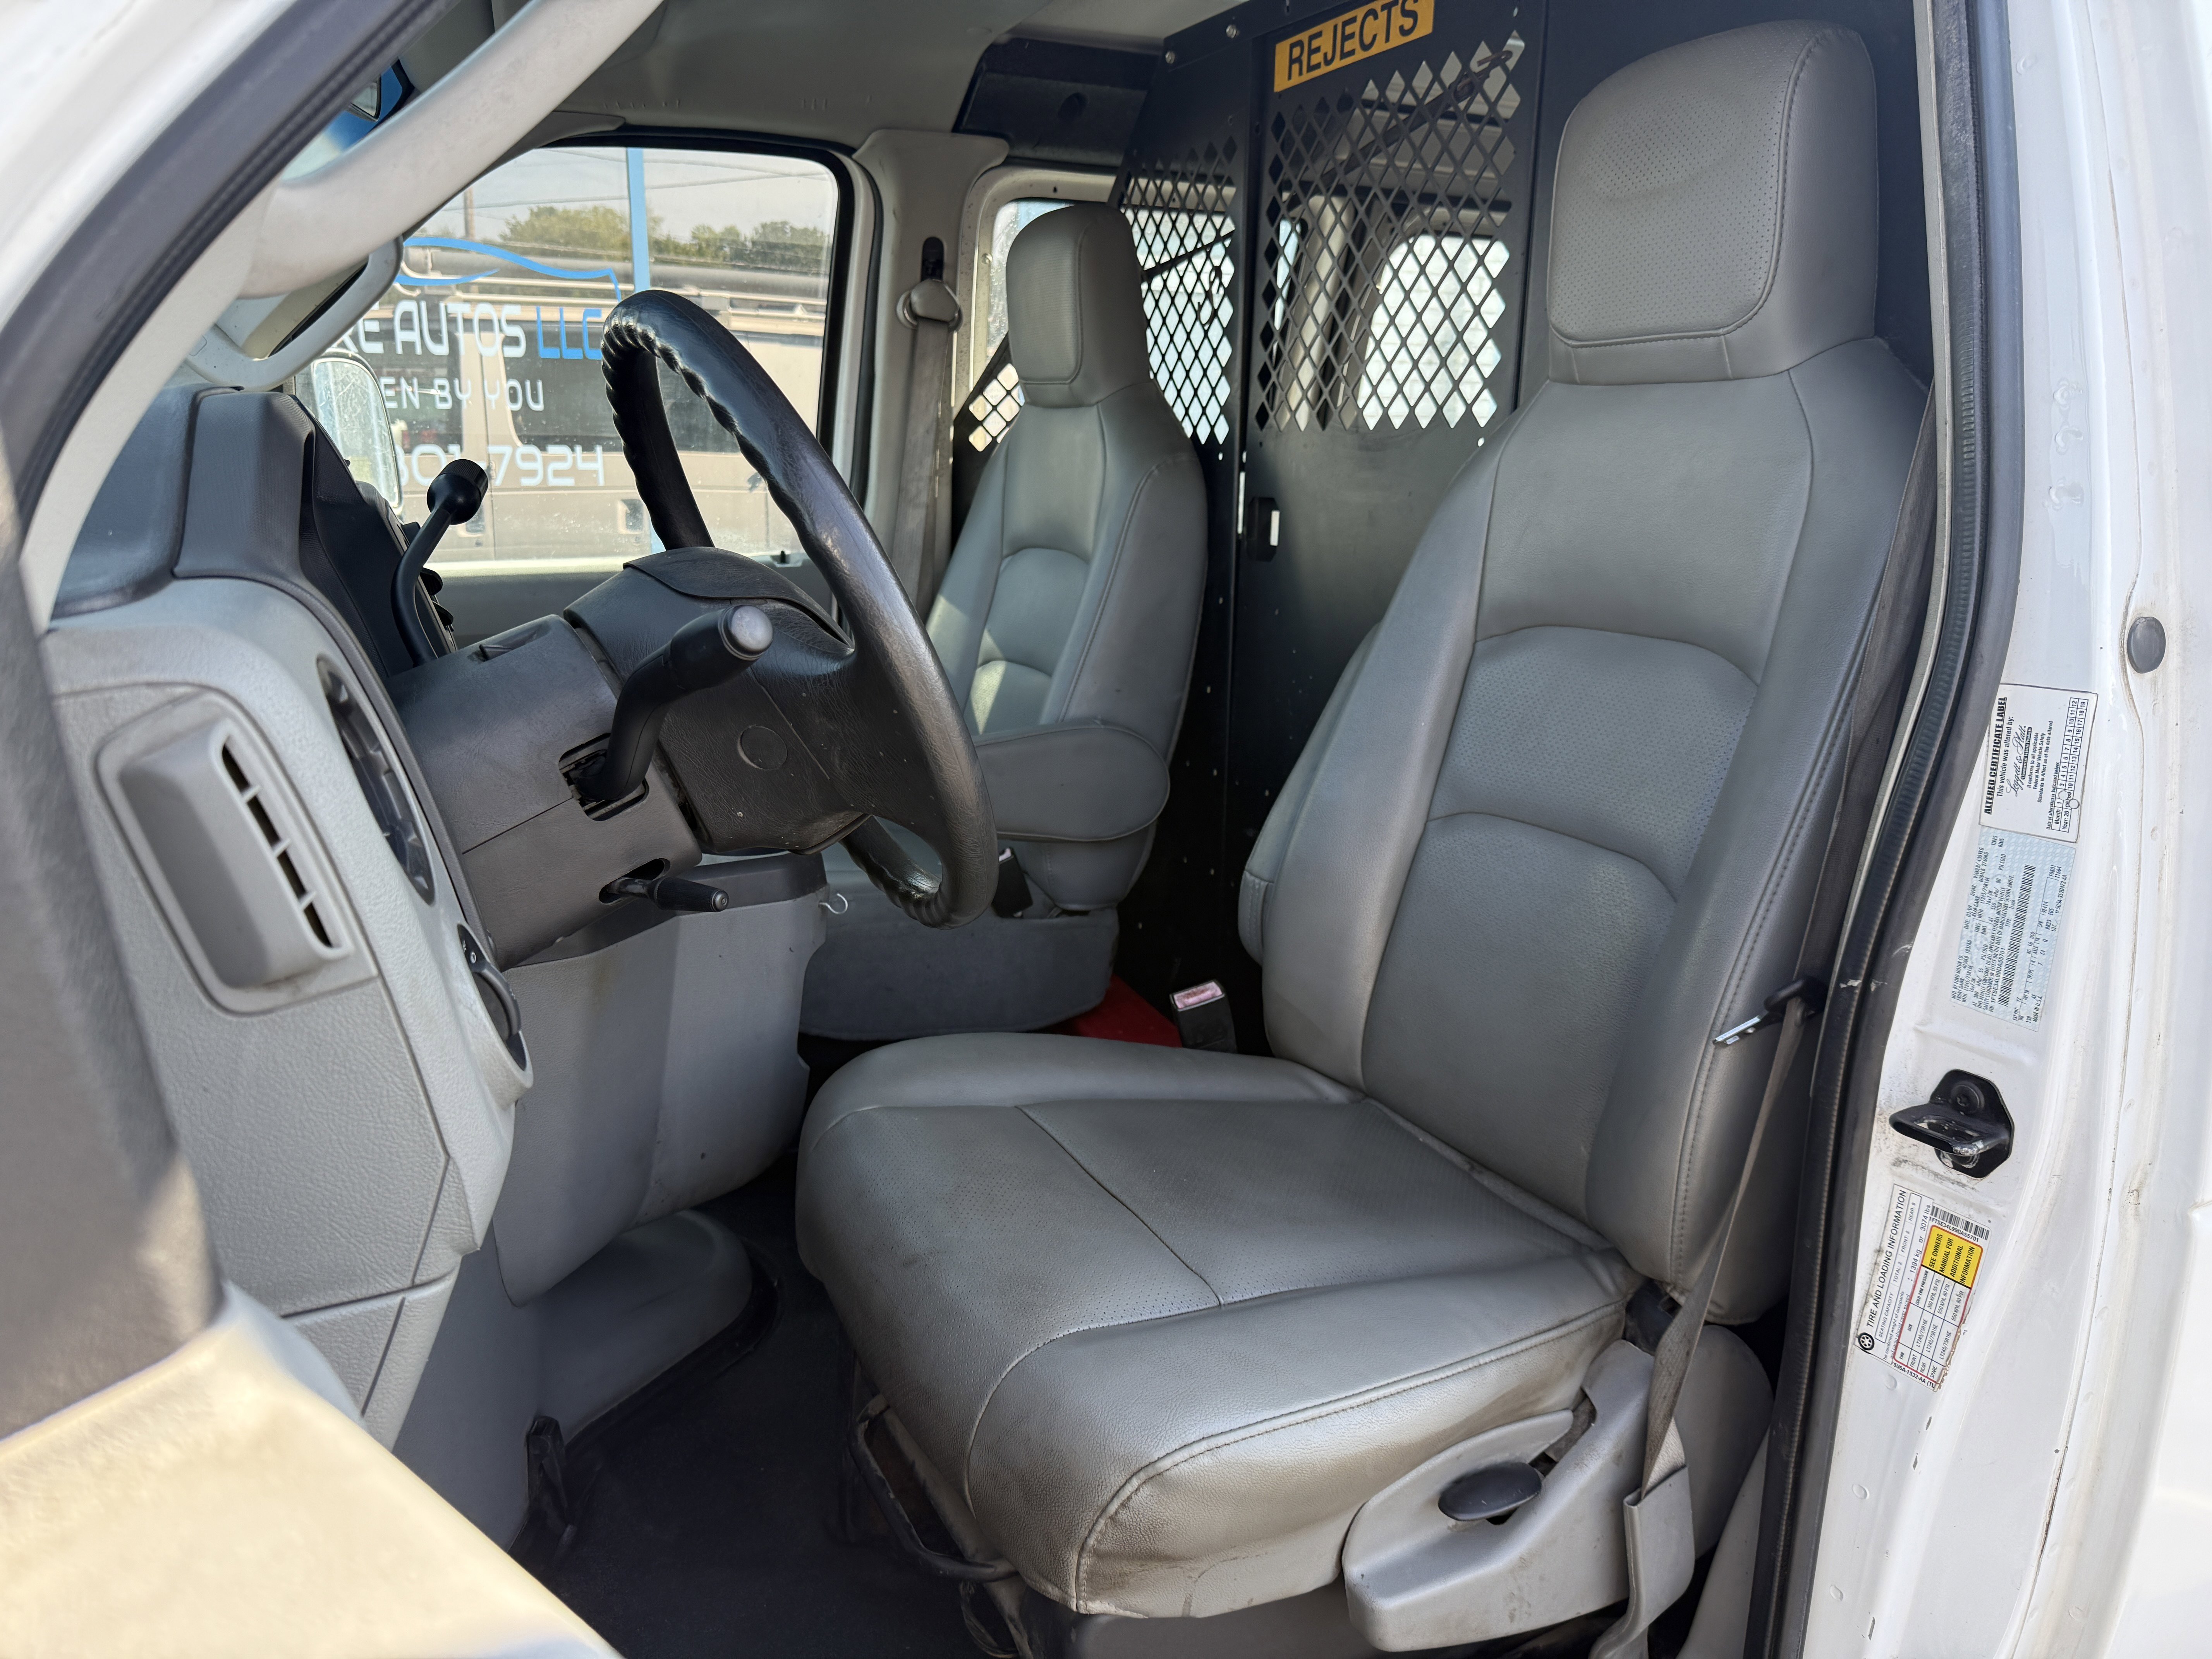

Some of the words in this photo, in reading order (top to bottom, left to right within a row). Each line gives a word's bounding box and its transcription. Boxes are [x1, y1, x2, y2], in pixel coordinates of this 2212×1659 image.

[1288, 0, 1418, 81] REJECTS
[393, 300, 526, 358] AUTOS
[536, 306, 603, 360] LLC
[434, 378, 471, 409] BY
[484, 379, 544, 411] YOU
[1996, 697, 2006, 722] LABEL
[2006, 716, 2014, 725] by:
[1989, 724, 2003, 777] CERTIFICATE
[2003, 726, 2012, 747] altered
[2015, 755, 2022, 763] &
[1996, 785, 2004, 797] This
[2005, 762, 2027, 797] Leggett
[1984, 779, 1995, 814] ALTERED
[2003, 888, 2011, 902] SHOWN
[1990, 948, 2005, 1003] 1FTSE34L99DA55701
[1920, 1215, 1928, 1231] 3074
[1866, 1308, 1877, 1327] TIRE
[1872, 1290, 1882, 1309] AND
[1877, 1250, 1892, 1289] LOADING
[1887, 1190, 1906, 1249] INFORMATION
[1913, 1249, 1922, 1257] kg
[1931, 1233, 1943, 1257] OWNERS
[1939, 1250, 1950, 1273] MANUAL
[1945, 1238, 1953, 1250] FOR
[1909, 1257, 1918, 1273] 1394
[1928, 1257, 1936, 1268] SEE
[1949, 1245, 1963, 1278] ADDITIONAL
[1959, 1246, 1975, 1284] INFORMATION
[1920, 1270, 1929, 1288] PRESSURE
[1878, 1317, 1887, 1338] SEATING
[1884, 1292, 1893, 1316] CAPACITY
[1885, 1333, 1893, 1354] combined
[1896, 1291, 1905, 1313] occupants
[1915, 1318, 1928, 1347] LT245/75R16E
[1925, 1323, 1938, 1353] LT245/75R16E
[1939, 1330, 1951, 1360] LT245/75R16E
